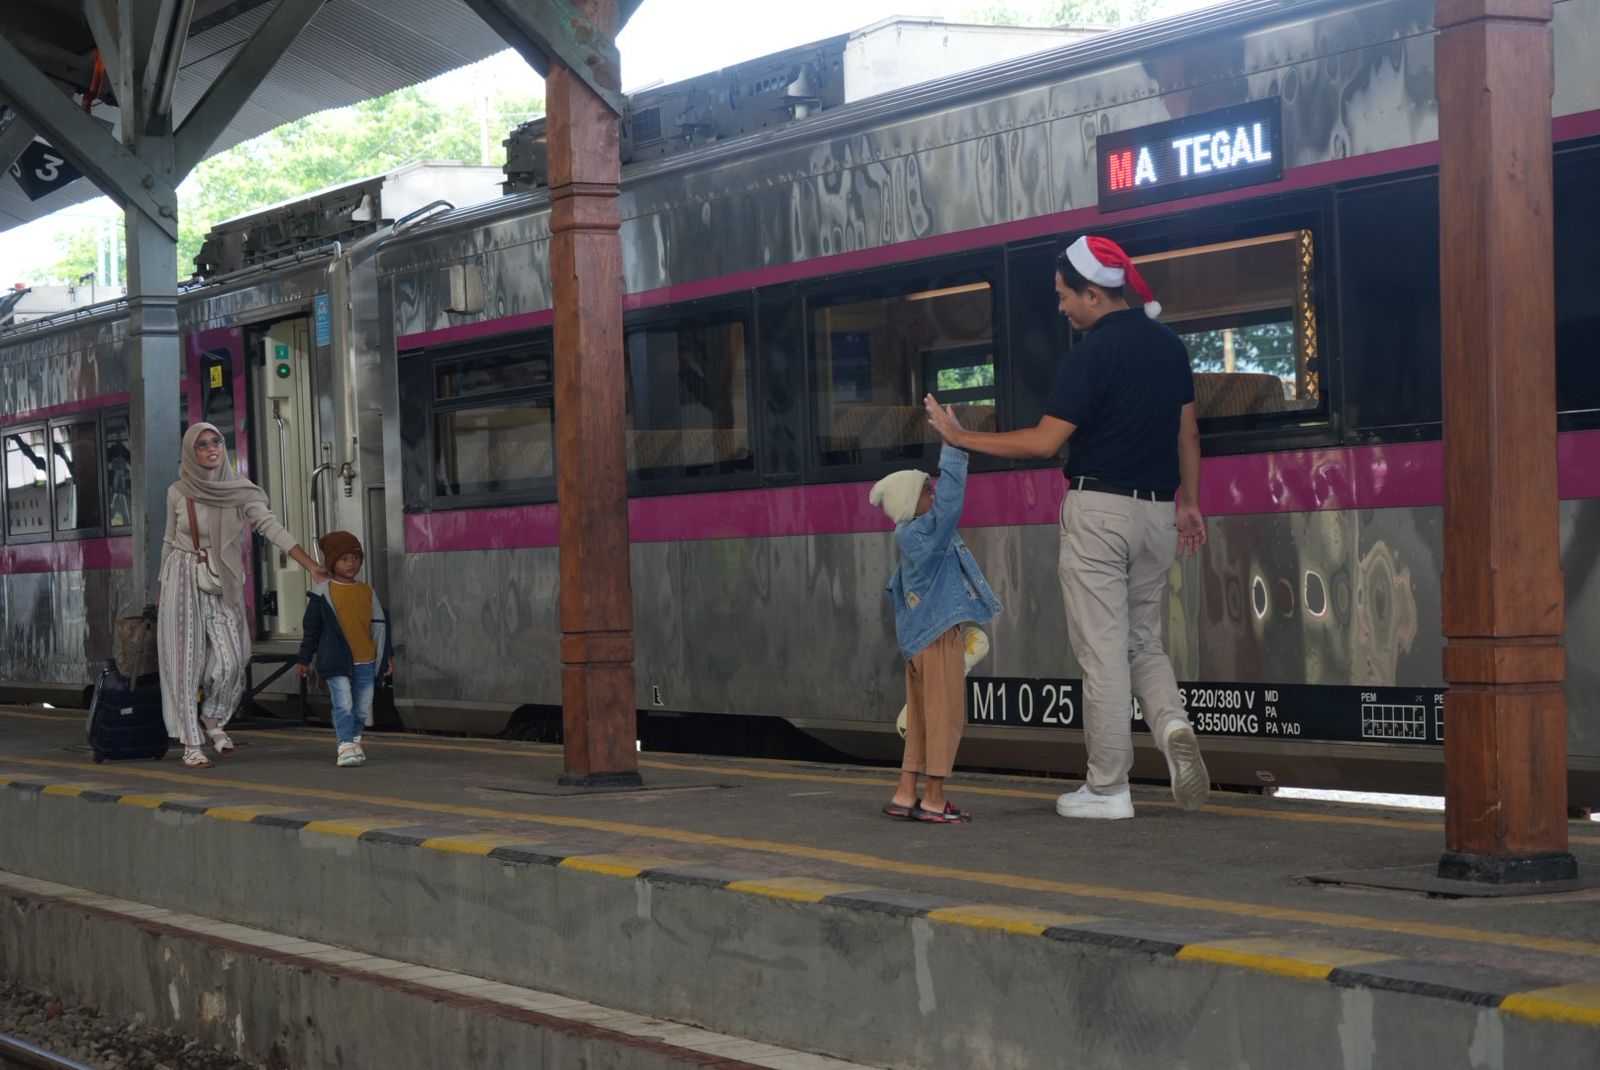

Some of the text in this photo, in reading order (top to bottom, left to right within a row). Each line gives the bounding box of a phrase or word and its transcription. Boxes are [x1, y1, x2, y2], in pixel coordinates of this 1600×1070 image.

[1172, 122, 1272, 177] TEGAL
[35, 153, 64, 181] 3
[973, 682, 1007, 720] M1
[1042, 685, 1074, 725] 25
[1190, 689, 1240, 709] 220/380
[1244, 690, 1255, 709] V
[1264, 690, 1279, 702] MD
[1361, 692, 1376, 703] PEM
[1434, 694, 1444, 704] PE
[1265, 706, 1277, 718] PA
[1197, 713, 1259, 734] 35500KG
[1266, 721, 1300, 735] PA YAD
